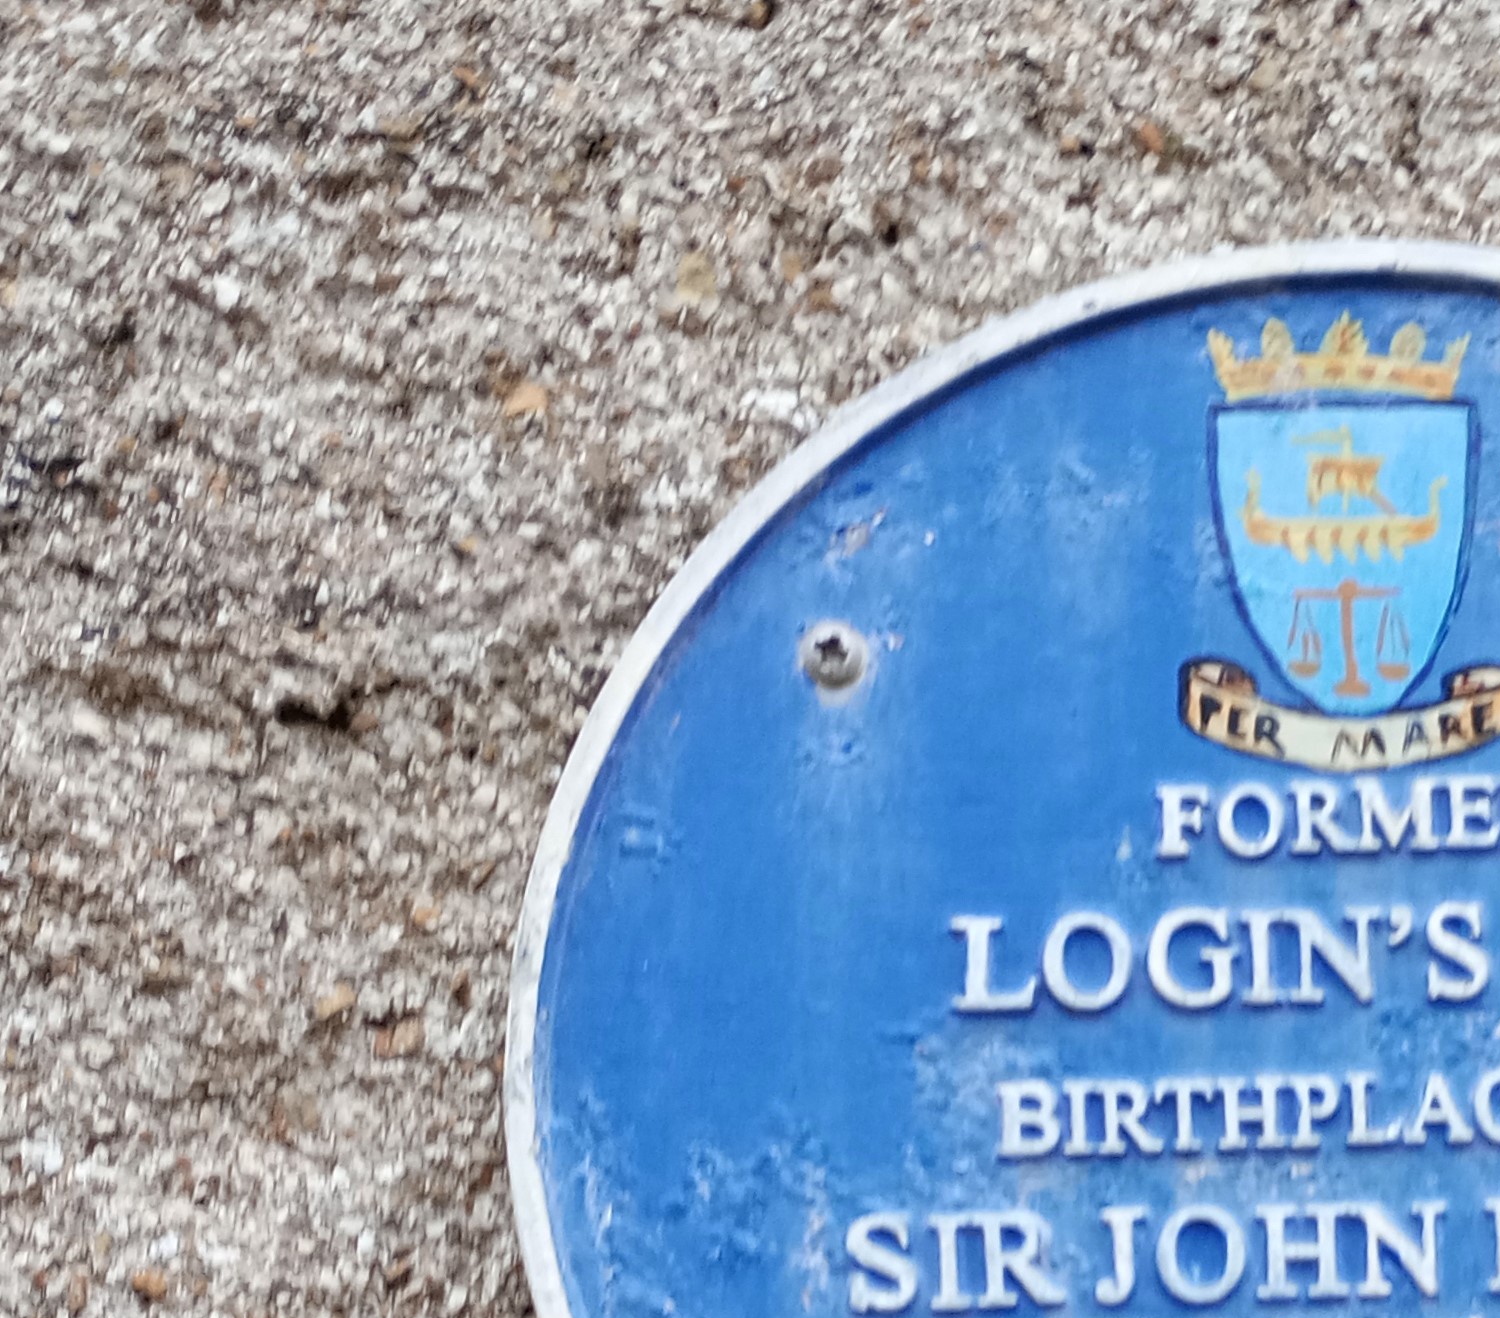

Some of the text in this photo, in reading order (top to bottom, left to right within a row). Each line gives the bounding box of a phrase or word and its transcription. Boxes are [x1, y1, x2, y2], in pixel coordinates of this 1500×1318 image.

[1198, 692, 1498, 765] PER MARE
[949, 900, 1491, 1012] LOGIN'S
[845, 1210, 1068, 1313] SIR
[1094, 1200, 1447, 1304] JOHN
